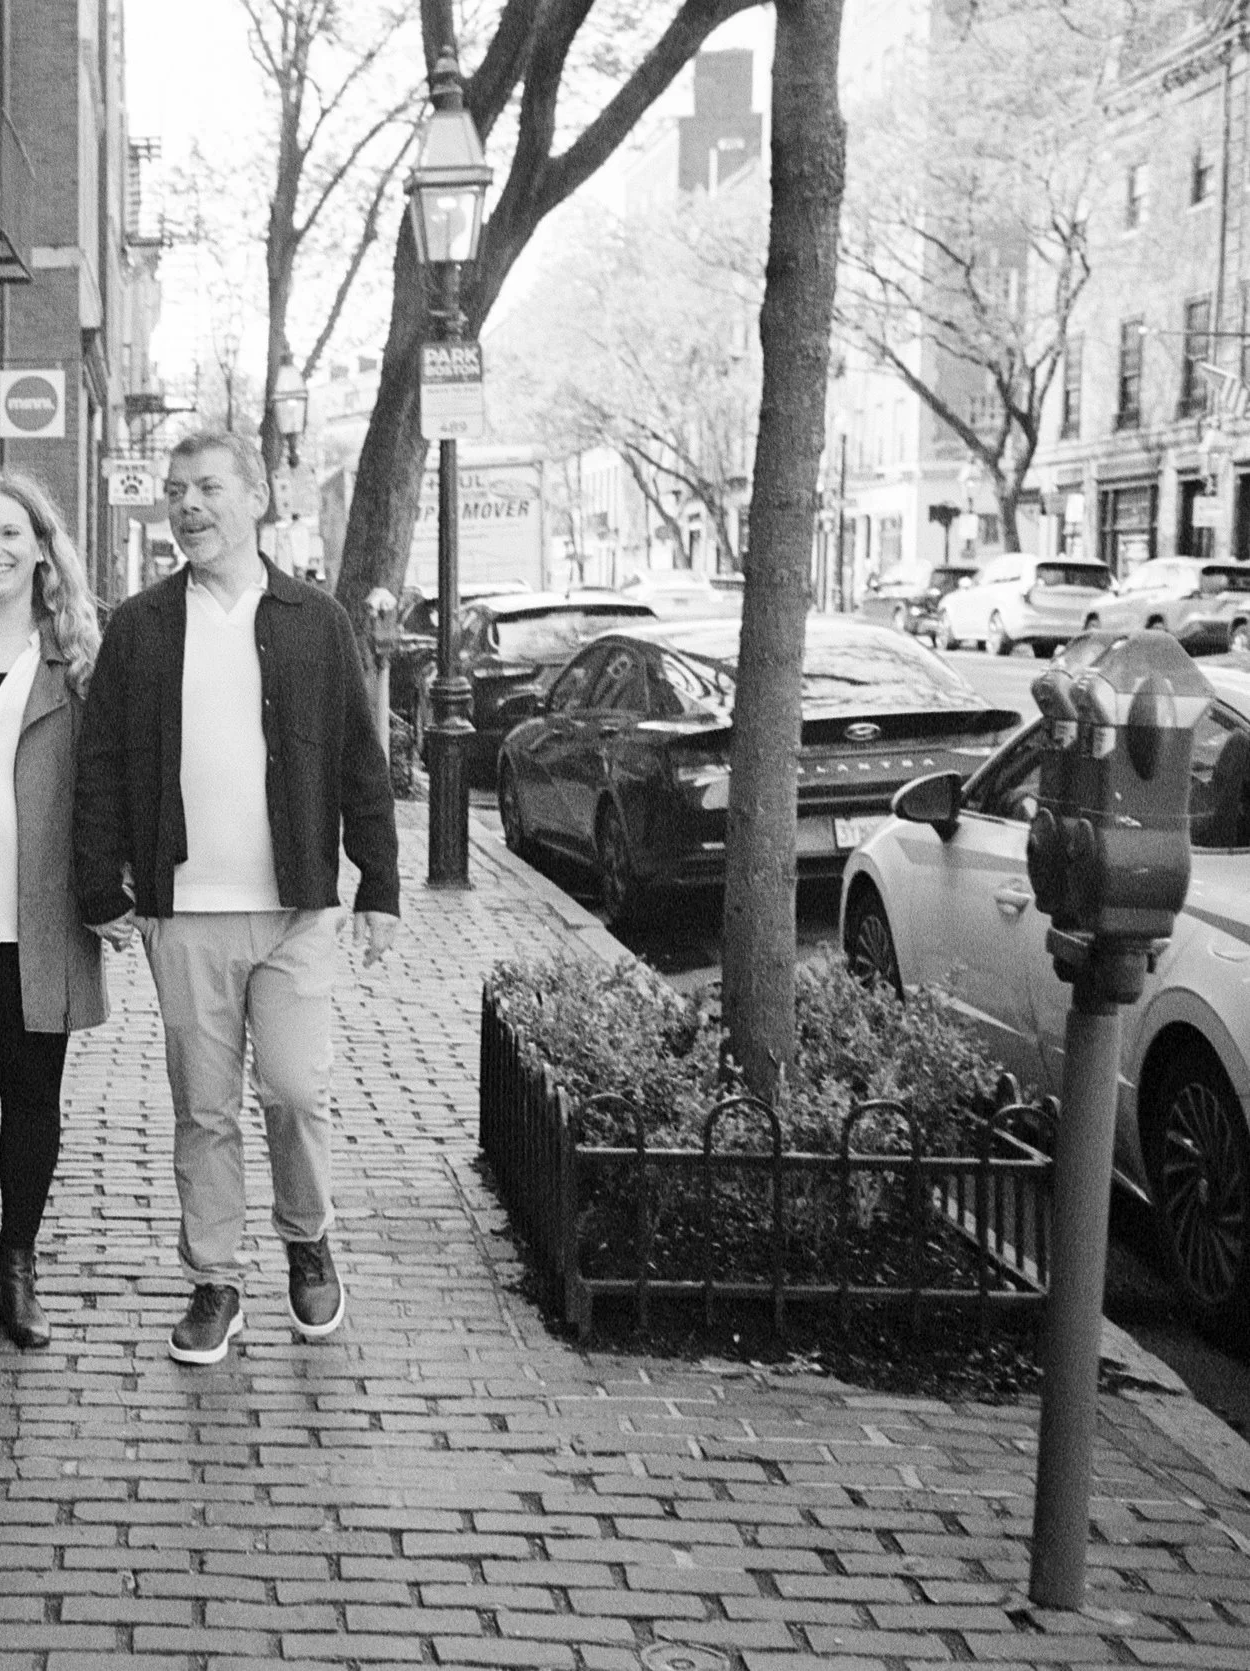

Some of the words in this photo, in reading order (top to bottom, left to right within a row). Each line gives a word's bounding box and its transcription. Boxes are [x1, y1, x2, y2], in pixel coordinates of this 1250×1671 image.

[423, 347, 480, 364] PARK
[423, 363, 481, 377] BOSTON
[461, 499, 530, 520] MOVER
